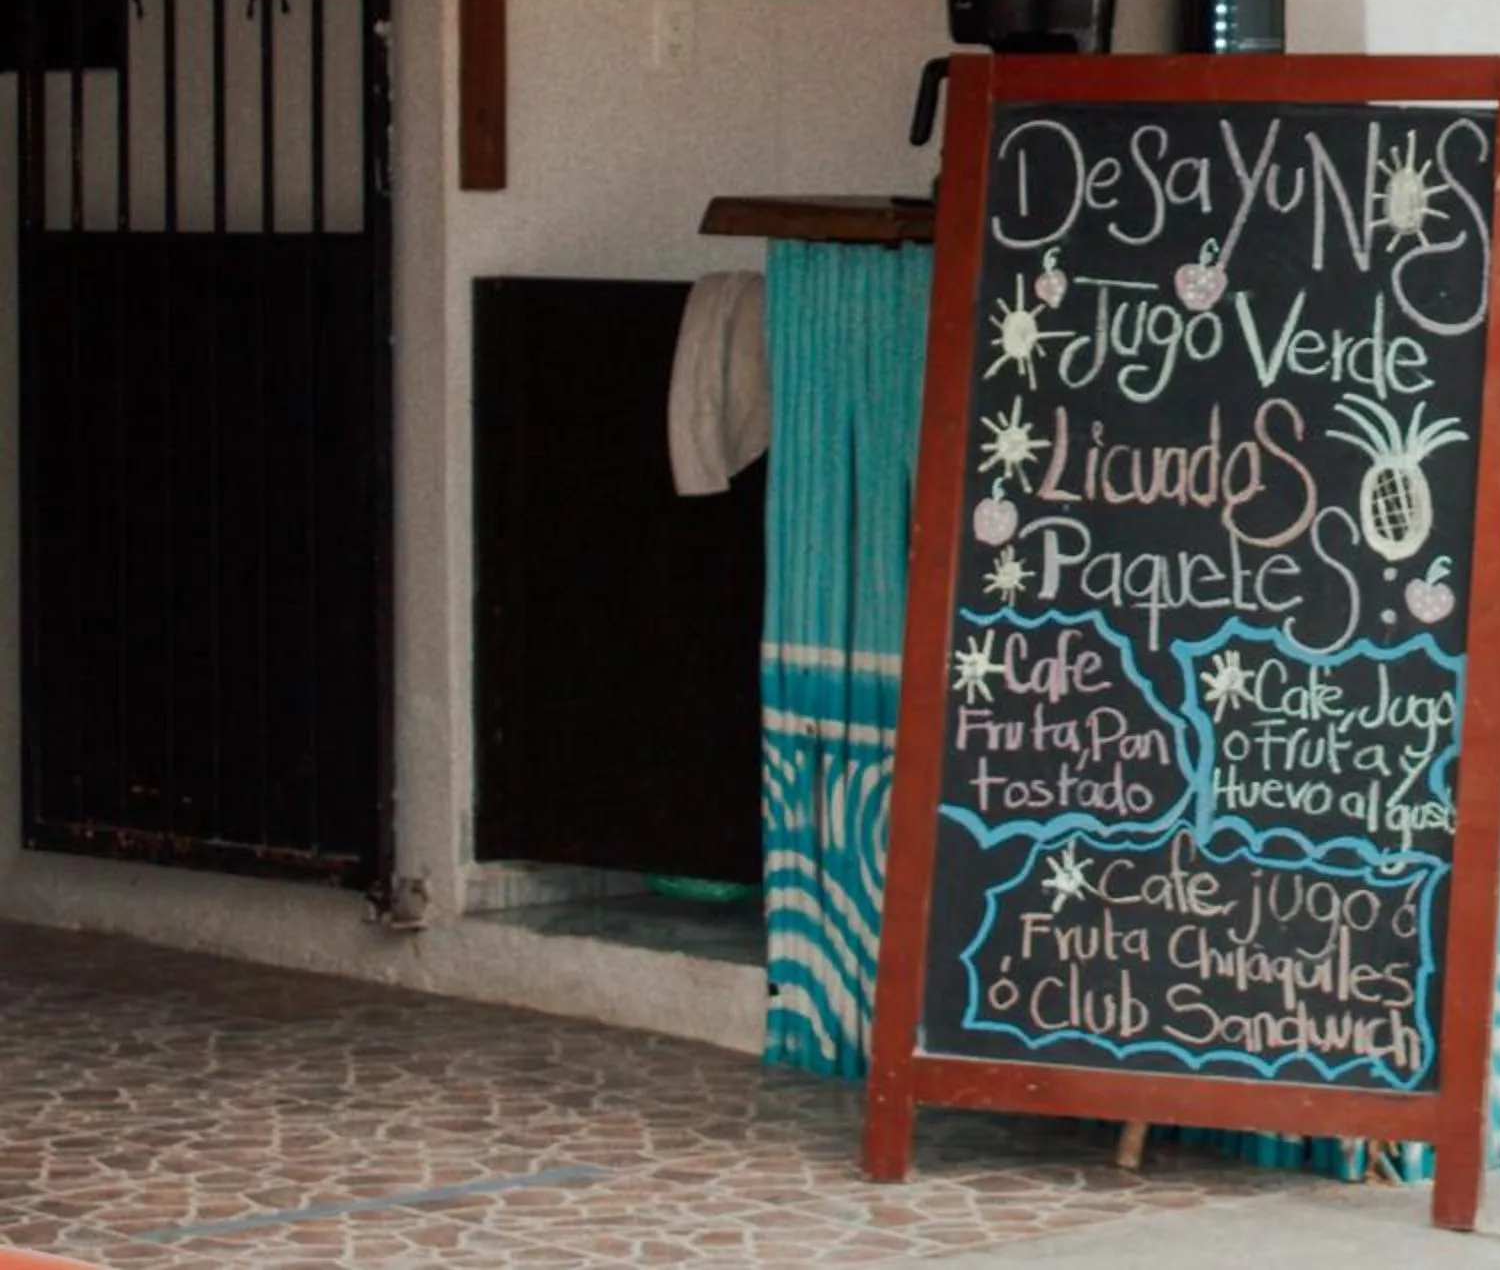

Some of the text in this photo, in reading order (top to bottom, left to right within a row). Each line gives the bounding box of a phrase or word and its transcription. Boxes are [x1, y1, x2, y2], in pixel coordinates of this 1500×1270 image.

[1059, 276, 1435, 403] Jugo Verde
[1085, 706, 1170, 764] Pan
[1251, 719, 1392, 776] Fruta
[1214, 763, 1333, 815] Huevo
[1340, 780, 1380, 832] al
[1019, 907, 1150, 962] Fruta
[1030, 962, 1150, 1038] Club
[1164, 983, 1421, 1071] Sandwich
